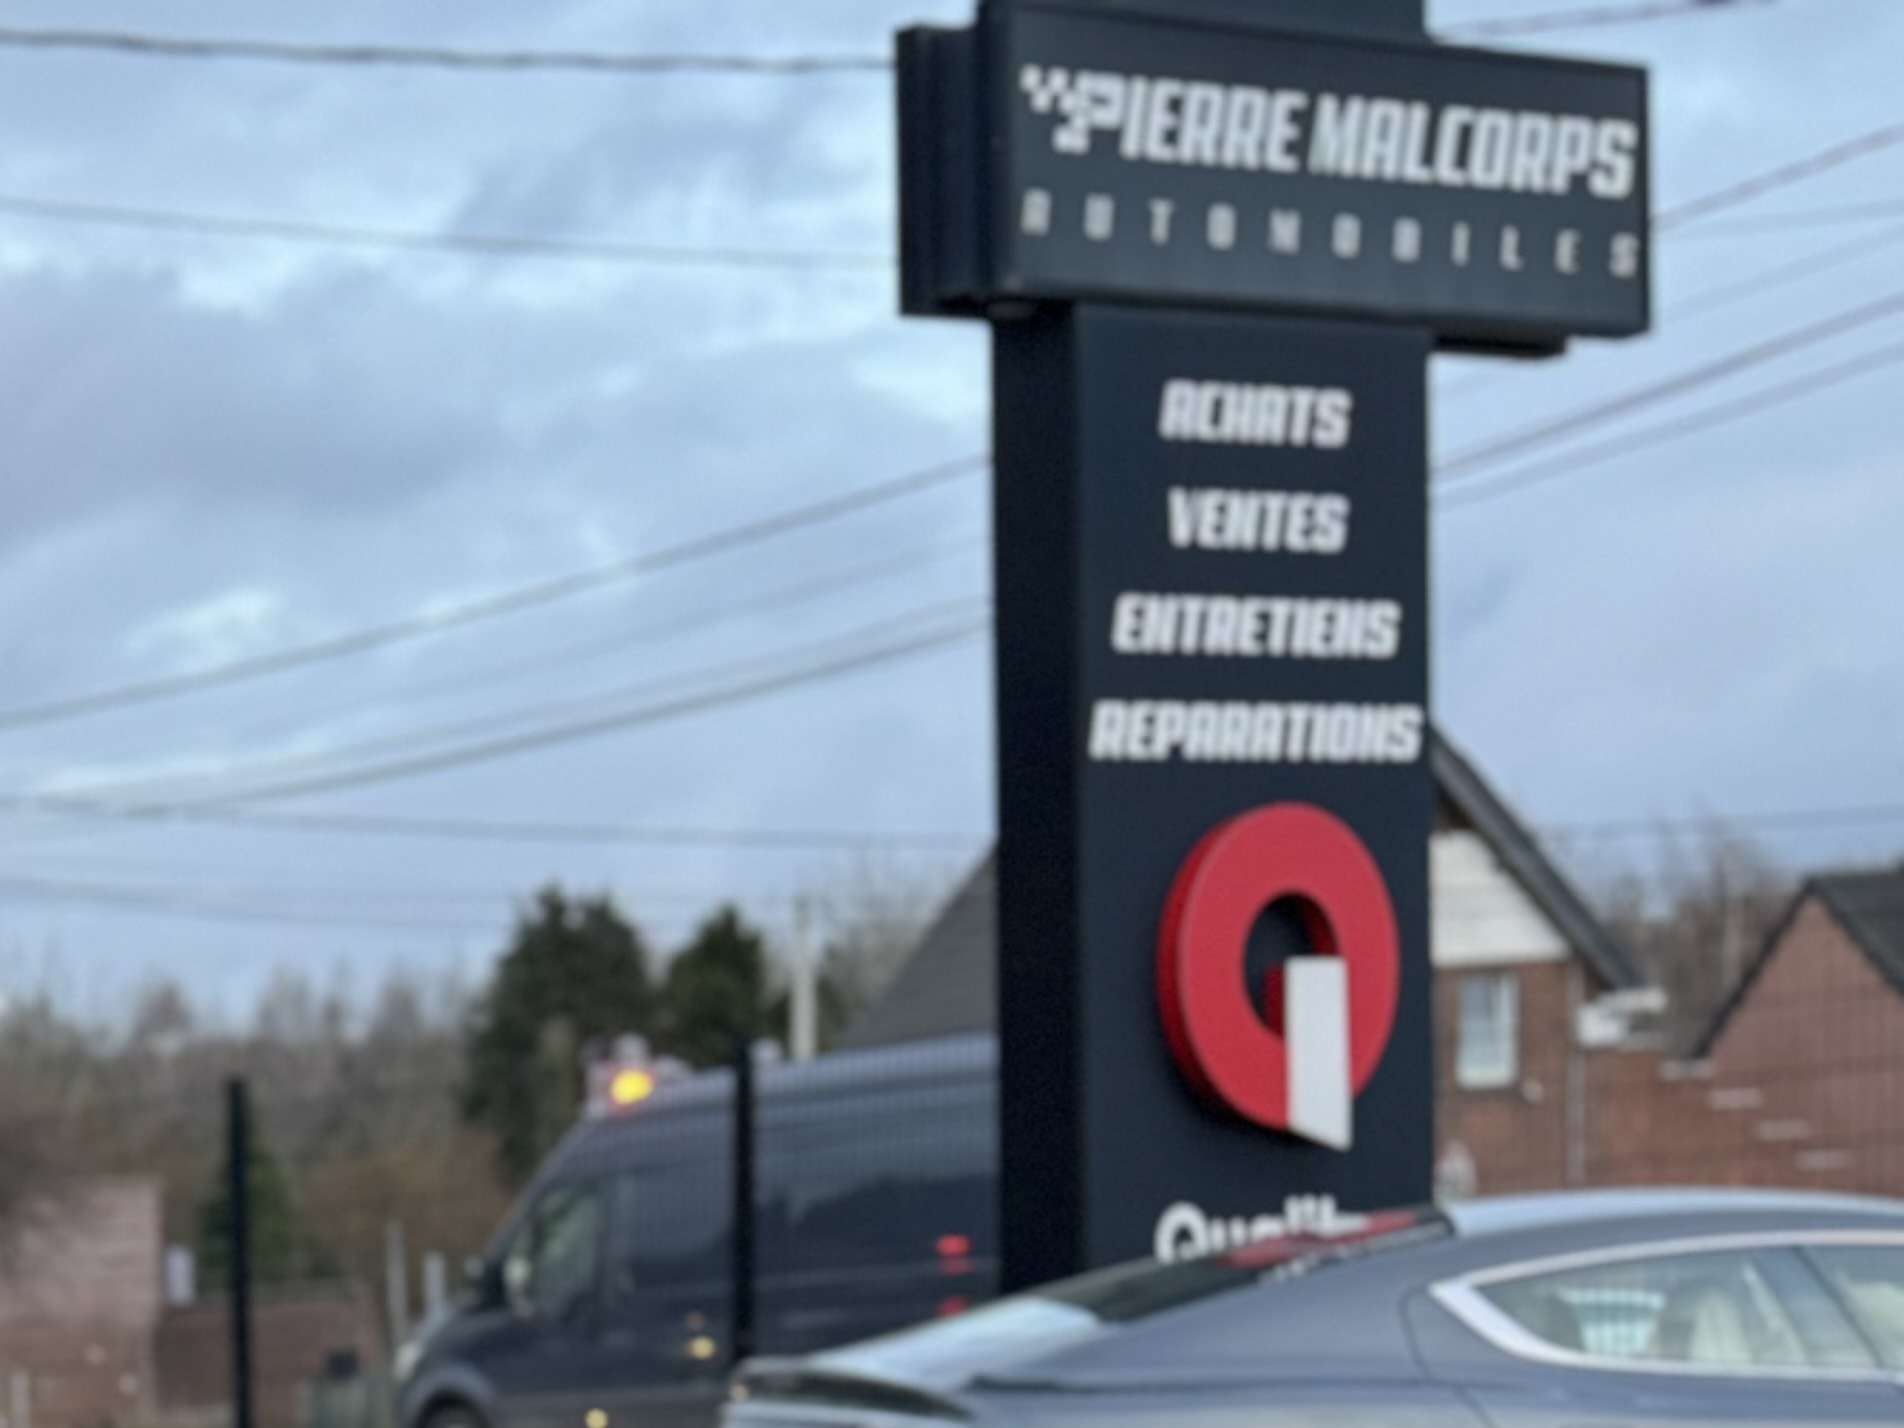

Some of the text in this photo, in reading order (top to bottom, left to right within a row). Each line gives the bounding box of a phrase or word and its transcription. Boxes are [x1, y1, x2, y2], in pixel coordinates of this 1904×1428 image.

[1048, 70, 1639, 199] PIERRE MALCORPS
[1020, 188, 1640, 280] AUTOMOBILES
[1157, 379, 1353, 449] ACHATS
[1167, 485, 1350, 555] VENTES
[1111, 591, 1402, 659] ENTRETIENS
[1088, 698, 1426, 763] REPARATIONS
